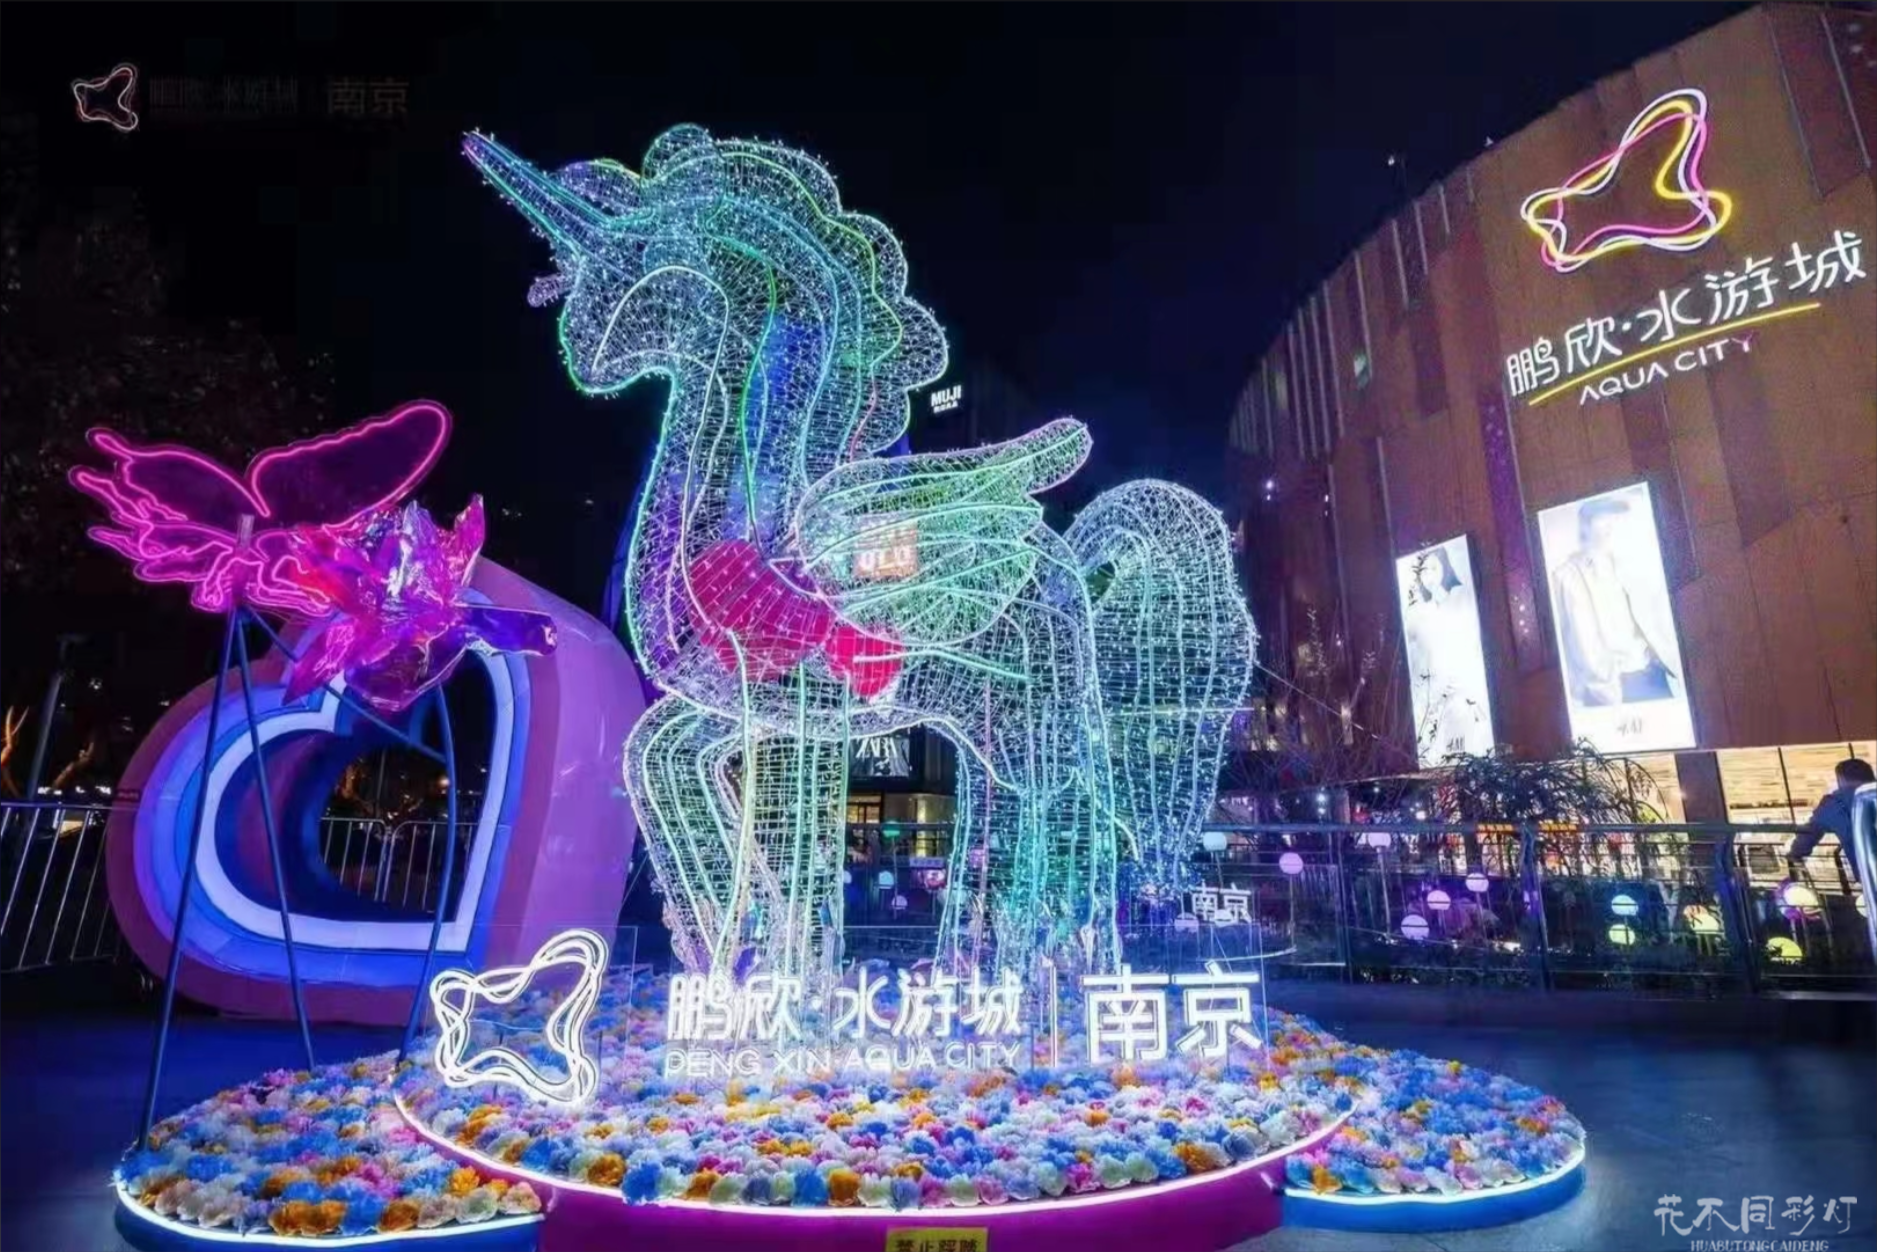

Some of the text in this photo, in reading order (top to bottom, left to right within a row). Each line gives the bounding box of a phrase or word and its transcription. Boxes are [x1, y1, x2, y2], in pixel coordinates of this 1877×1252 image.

[1506, 230, 1867, 397] 鹏欣·水游城
[931, 385, 961, 407] MUJI
[1579, 333, 1755, 406] AQUA CITY
[1191, 879, 1253, 924] 南京
[667, 960, 1264, 1064] 鹏欣·水游城 南京
[664, 1040, 1021, 1080] PENG XIN AQUA CITY
